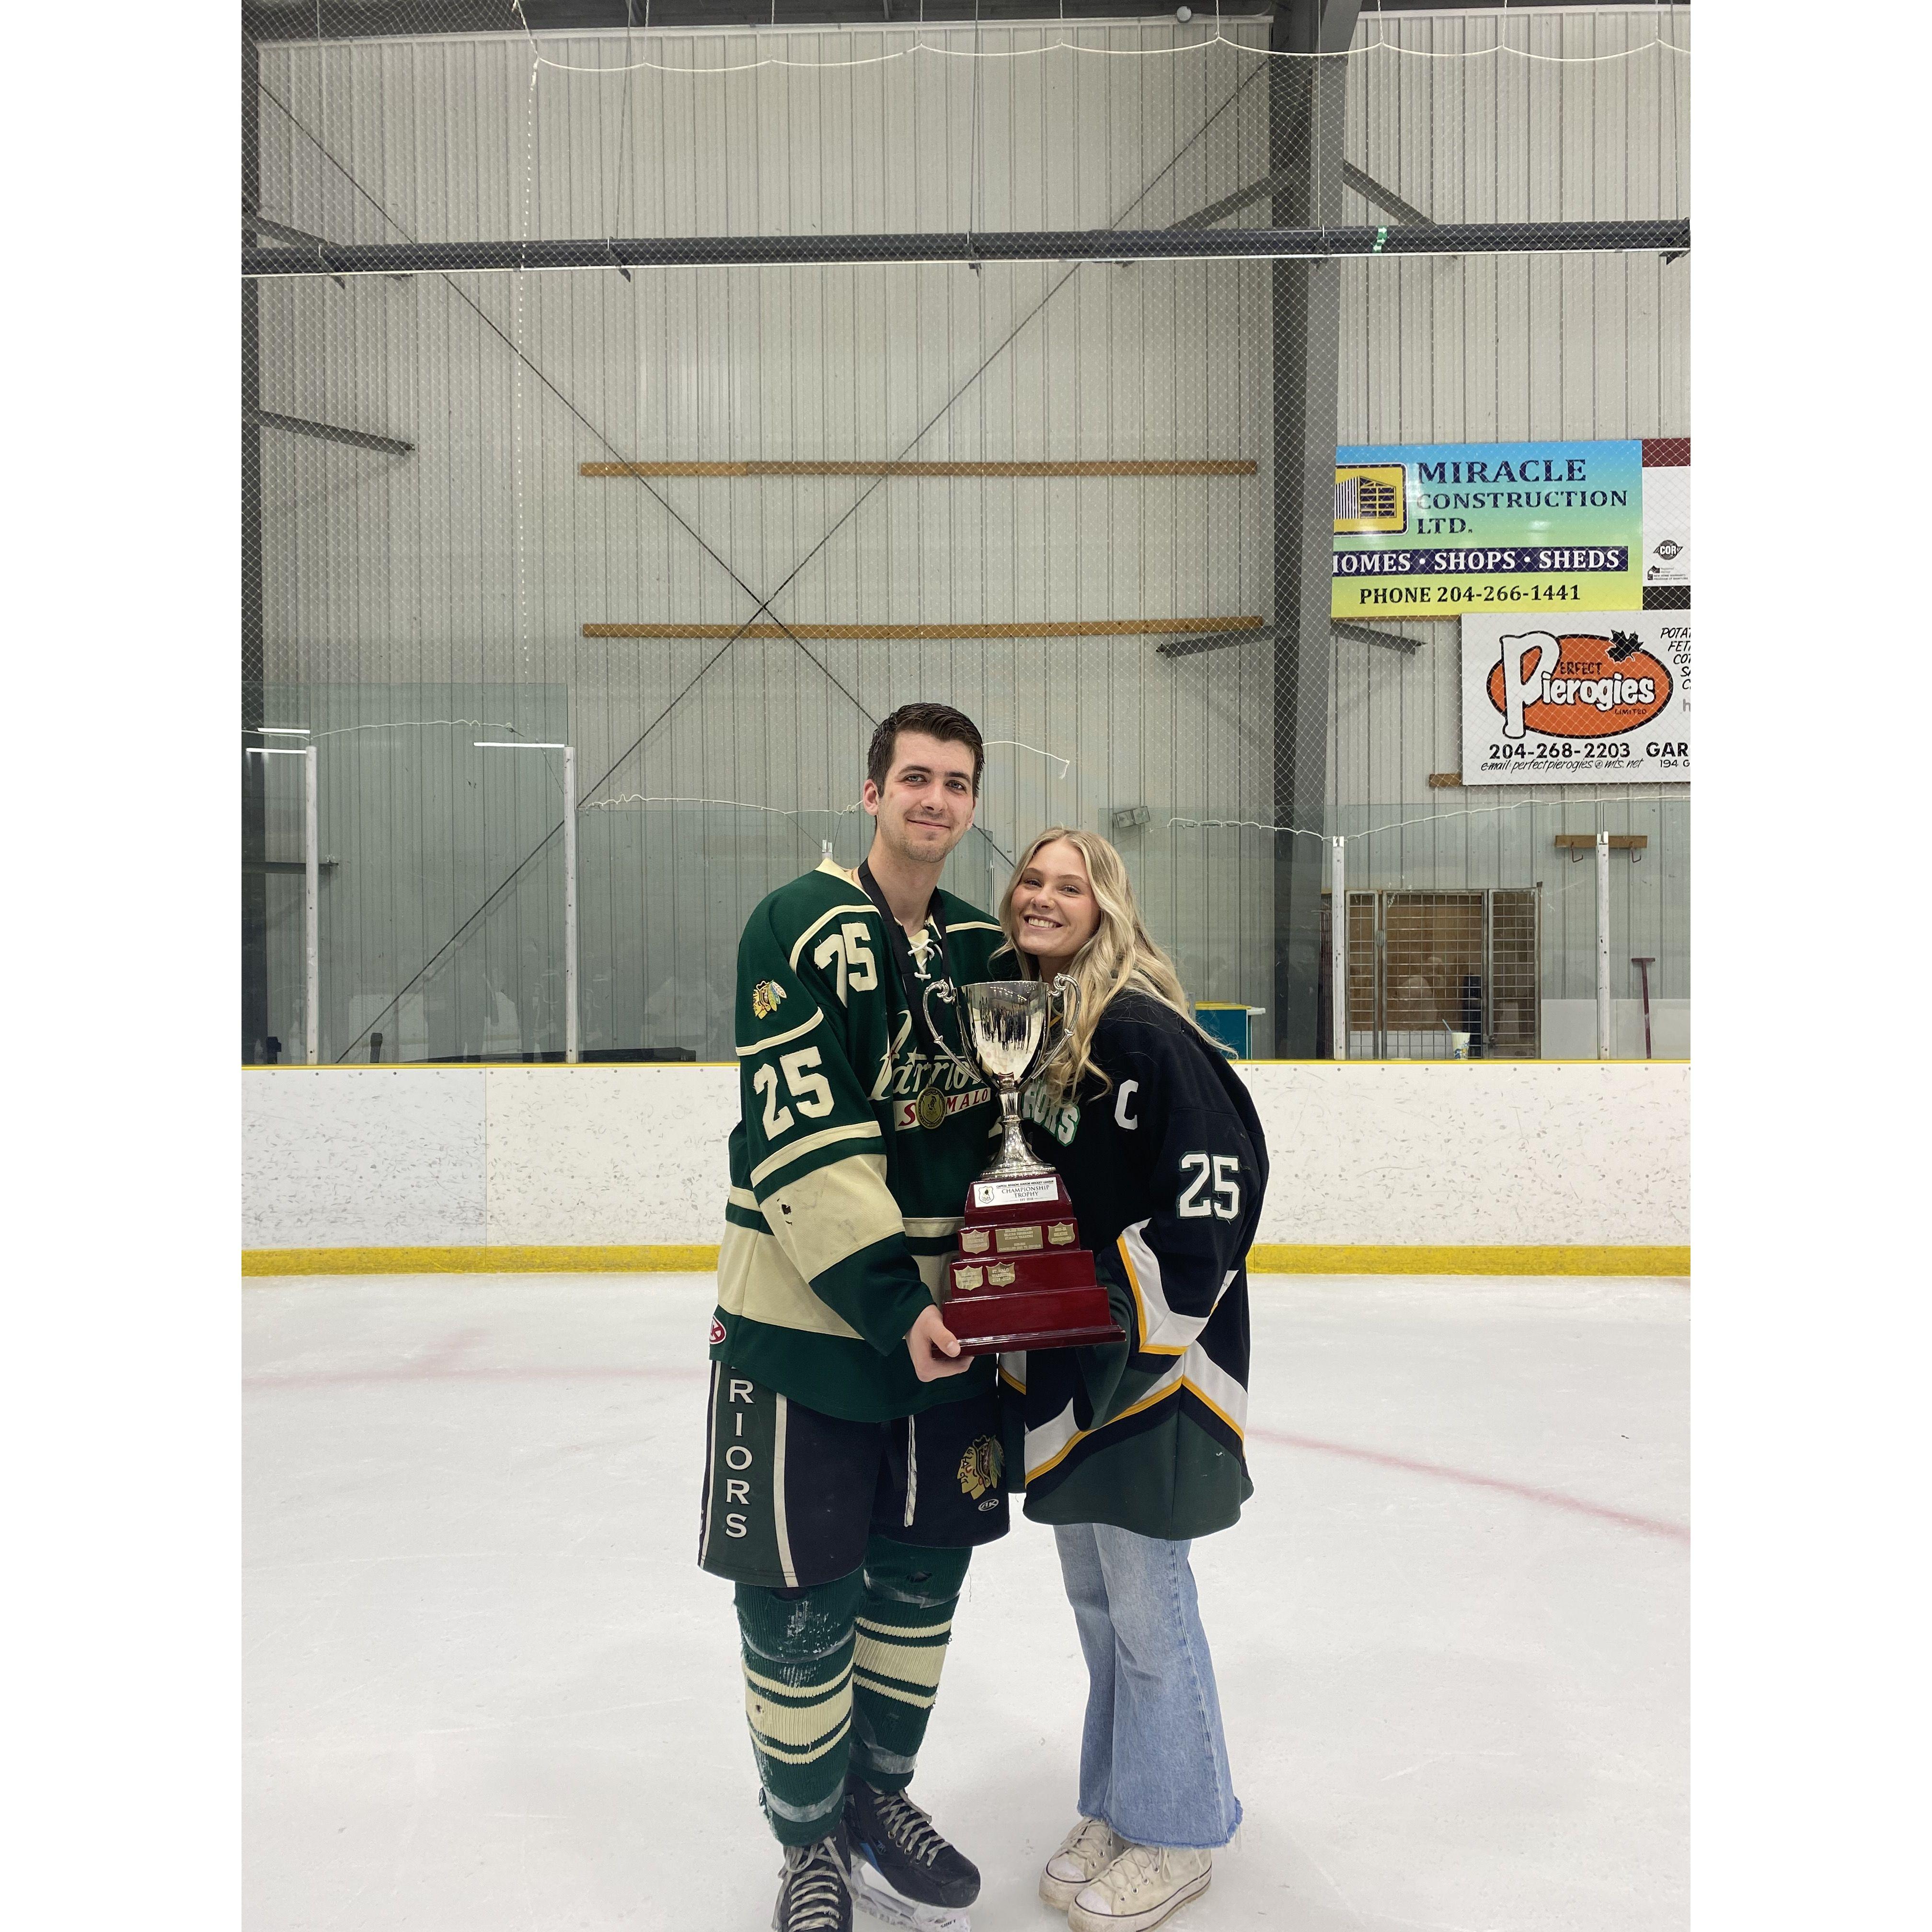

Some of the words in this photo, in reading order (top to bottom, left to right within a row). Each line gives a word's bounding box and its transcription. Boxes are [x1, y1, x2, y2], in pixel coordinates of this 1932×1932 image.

[1417, 459, 1587, 485] MIRACLE
[1416, 490, 1628, 510] CONSTRUCTION
[1416, 518, 1473, 535] LTD.
[1434, 550, 1516, 571] SHOPS
[1539, 549, 1620, 570] SHEDS
[1659, 545, 1677, 555] COR
[1359, 587, 1431, 604] PHONE
[1437, 584, 1581, 603] 204-266-1441
[1499, 631, 1656, 739] Pierogies
[1489, 743, 1630, 759] 204-268-2203
[1645, 742, 1689, 757] GAR
[1659, 759, 1678, 768] 194
[753, 1046, 835, 1141] 25
[946, 1088, 989, 1115] MALO
[1114, 1079, 1139, 1130] C
[1001, 1184, 1050, 1194] CHAMPIONSHIP
[1176, 1150, 1242, 1221] 25
[725, 1366, 754, 1539] RIORS
